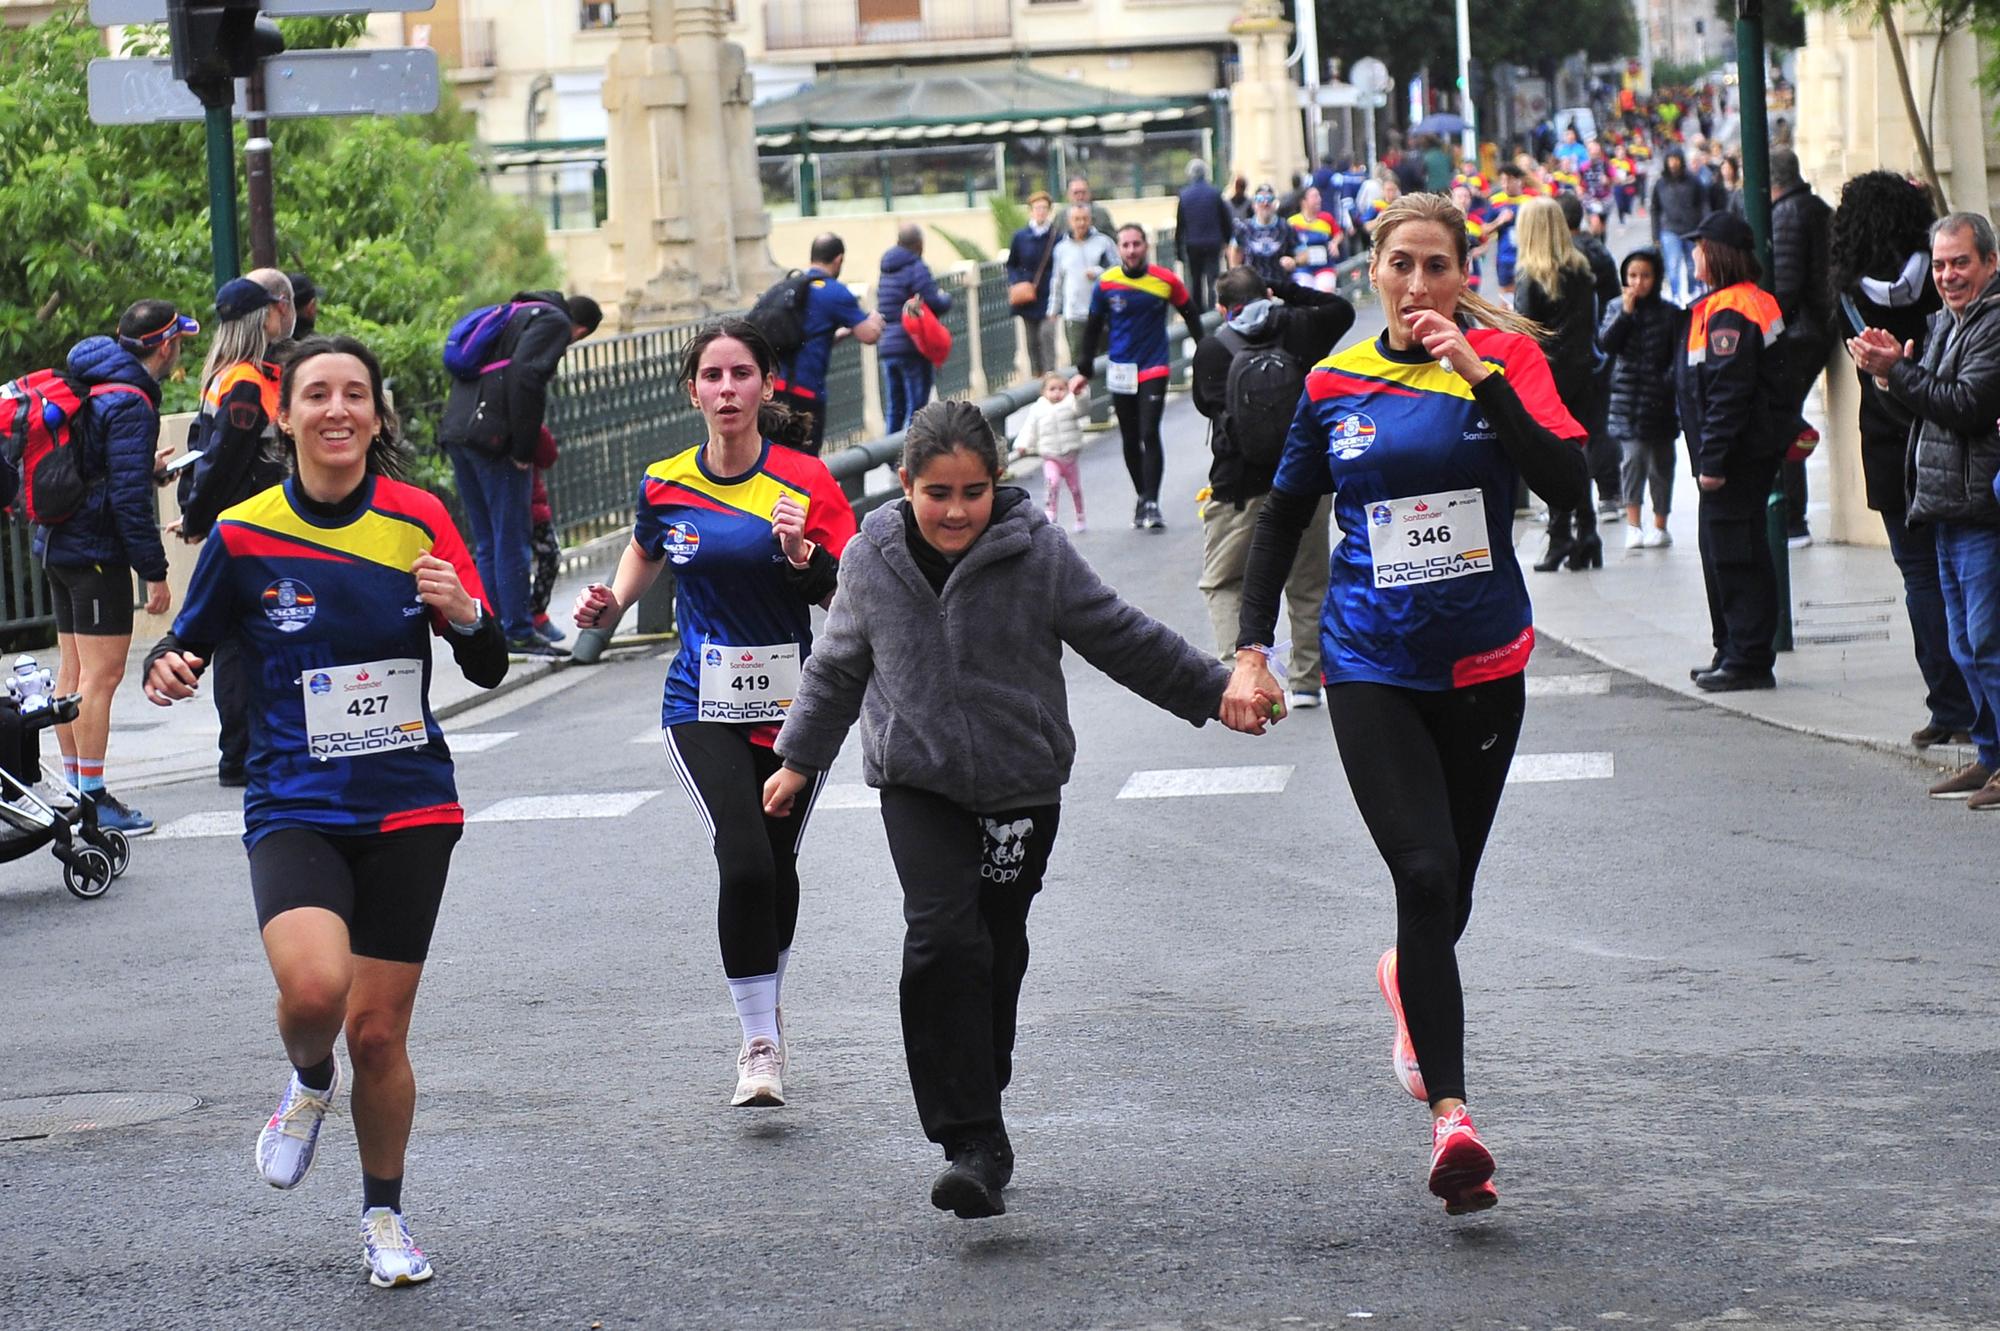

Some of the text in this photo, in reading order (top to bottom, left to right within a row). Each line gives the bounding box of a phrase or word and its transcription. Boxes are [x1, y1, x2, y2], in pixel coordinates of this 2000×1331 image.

[1463, 431, 1497, 441] Santand
[1403, 511, 1443, 523] Santander
[1407, 525, 1452, 547] 346
[1376, 553, 1466, 574] POLICIA
[1377, 561, 1491, 585] NACIONAL
[730, 661, 765, 670] Santander
[343, 680, 383, 693] Santander
[731, 675, 770, 690] 419
[347, 695, 389, 717] 427
[701, 700, 779, 710] POLICIA
[701, 709, 788, 720] NACIONA
[311, 725, 403, 745] POLICIA
[311, 732, 425, 755] NACIONAL
[980, 864, 1022, 883] OOPY
